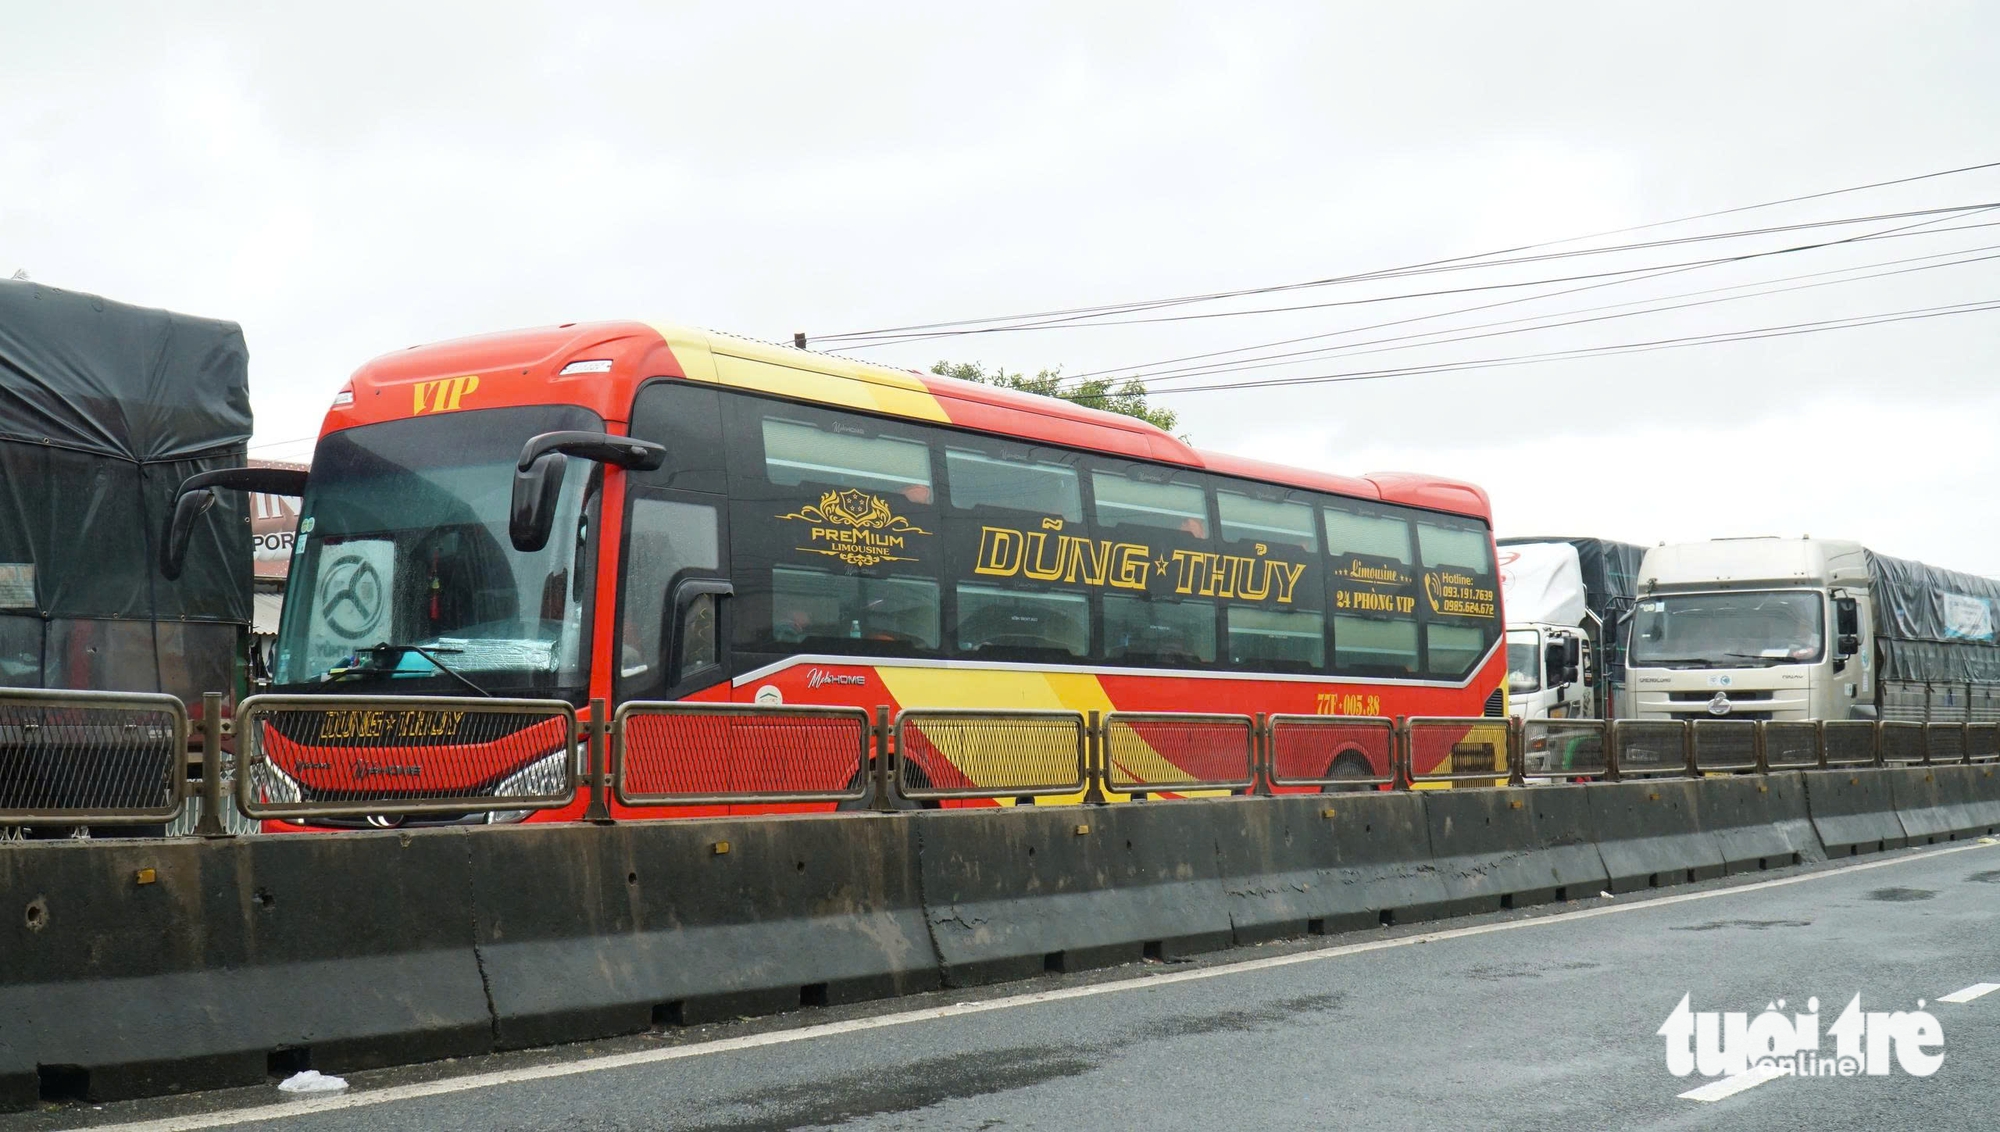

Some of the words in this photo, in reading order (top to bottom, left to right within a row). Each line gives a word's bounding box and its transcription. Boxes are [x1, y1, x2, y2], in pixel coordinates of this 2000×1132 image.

[413, 375, 479, 416] VIP
[812, 528, 904, 548] PREMIUM
[831, 542, 890, 556] LIMOUSINE
[974, 518, 1149, 590] DŨNG
[1172, 543, 1306, 603] THỦY
[1350, 559, 1398, 581] Limousine
[1442, 572, 1474, 586] Hotline:
[1336, 590, 1351, 608] 24
[1353, 587, 1395, 612] PHÒNG
[1395, 596, 1415, 613] VIP
[1442, 586, 1493, 602] 093.191.7639
[1444, 600, 1494, 615] 0985.624.672
